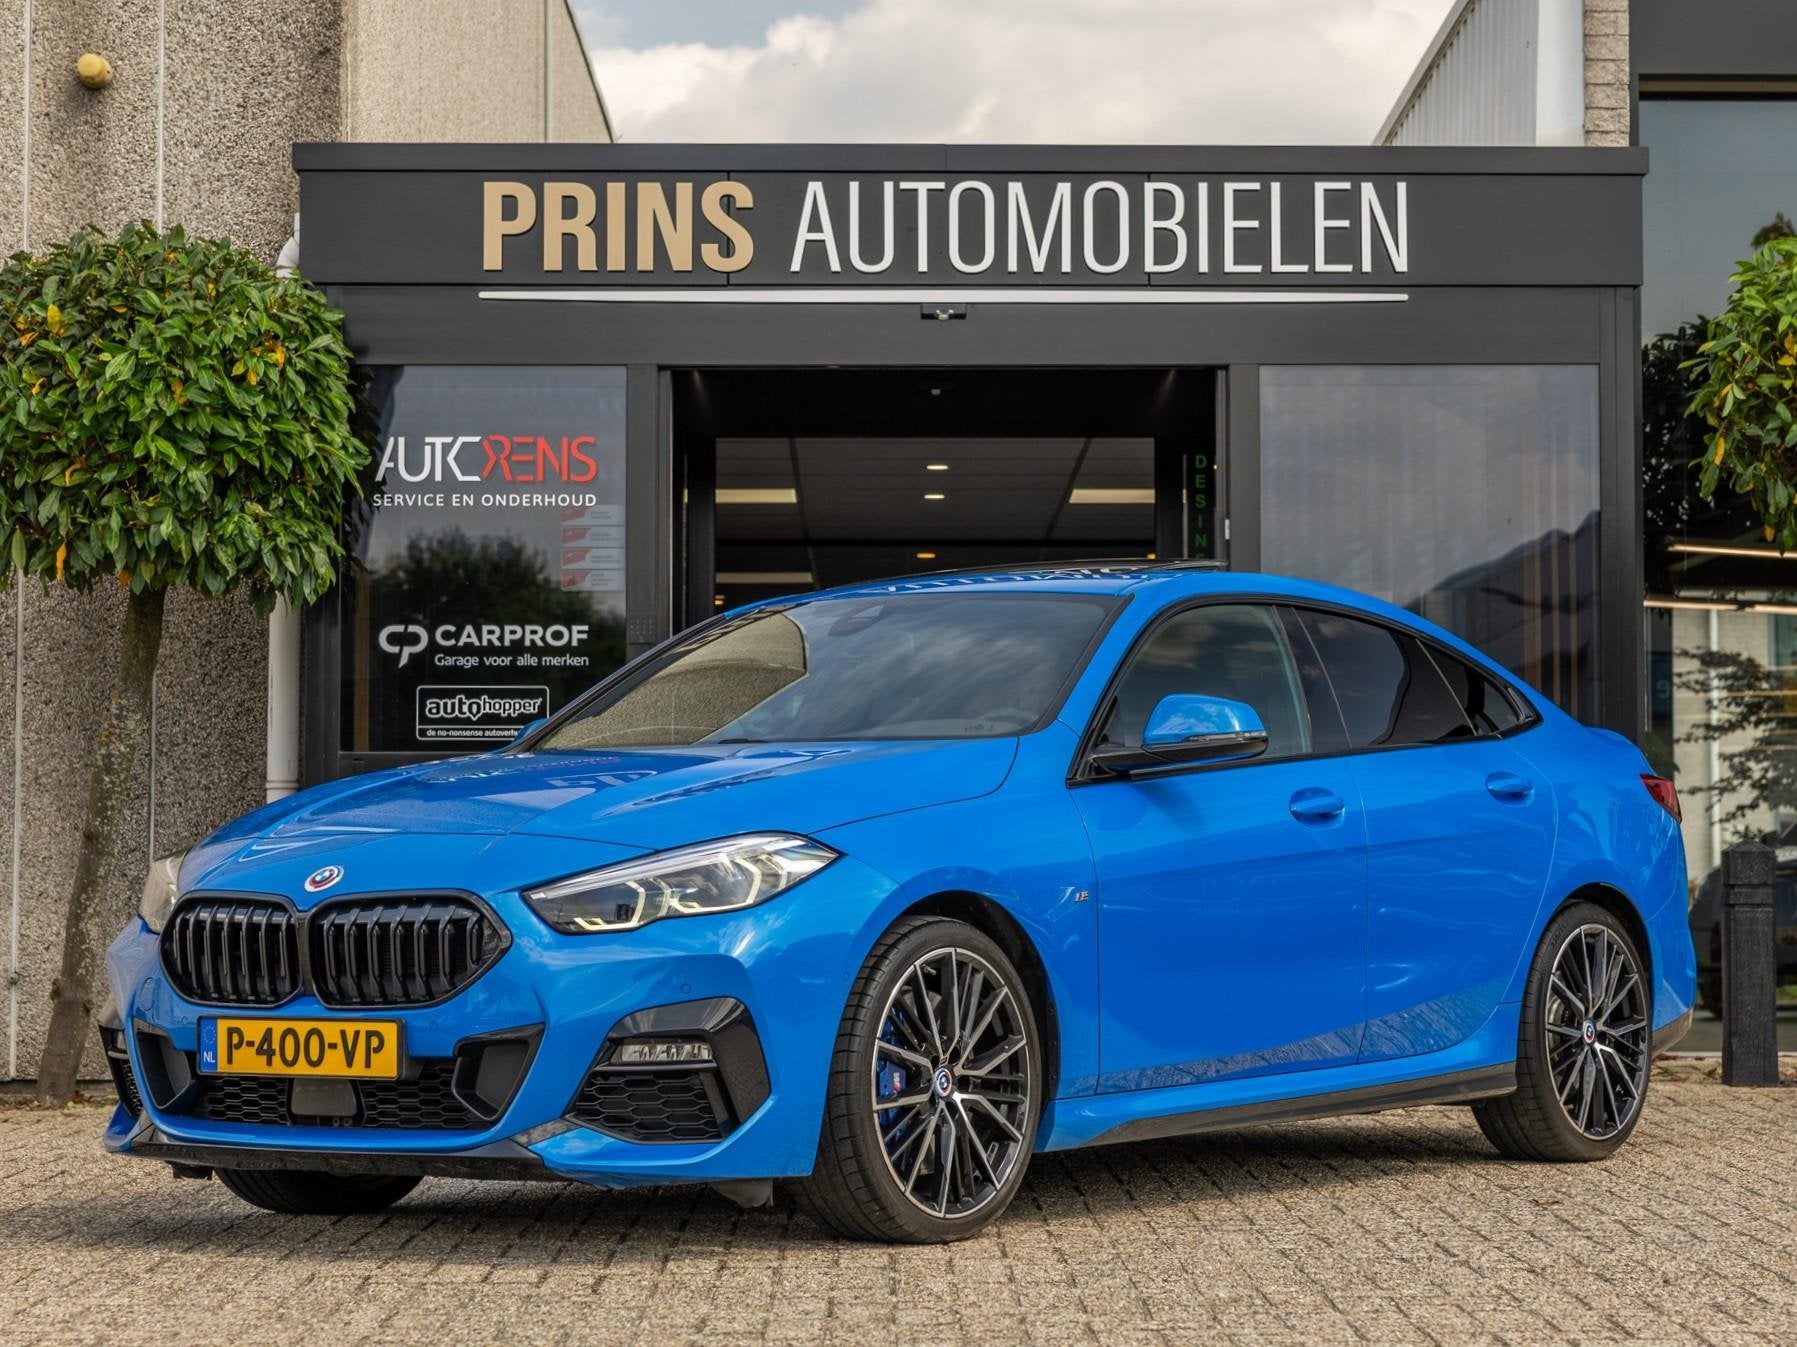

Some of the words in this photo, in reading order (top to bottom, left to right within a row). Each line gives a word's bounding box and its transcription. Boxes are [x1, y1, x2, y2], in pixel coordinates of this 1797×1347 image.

[483, 180, 755, 273] PRINS
[790, 180, 1409, 274] AUTOMOBIELEN
[373, 494, 445, 507] SERVICE
[452, 494, 474, 507] EN
[481, 494, 597, 507] ONDERHOUD
[434, 624, 589, 647] CARPROF
[434, 653, 480, 669] Garage
[484, 655, 513, 667] voor
[516, 653, 539, 667] alle
[542, 653, 589, 667] merken
[425, 694, 543, 721] autohopper
[426, 729, 437, 737] de
[437, 729, 484, 737] no-nonsense
[203, 1051, 216, 1063] NL
[226, 1027, 385, 1069] P-400-VP
